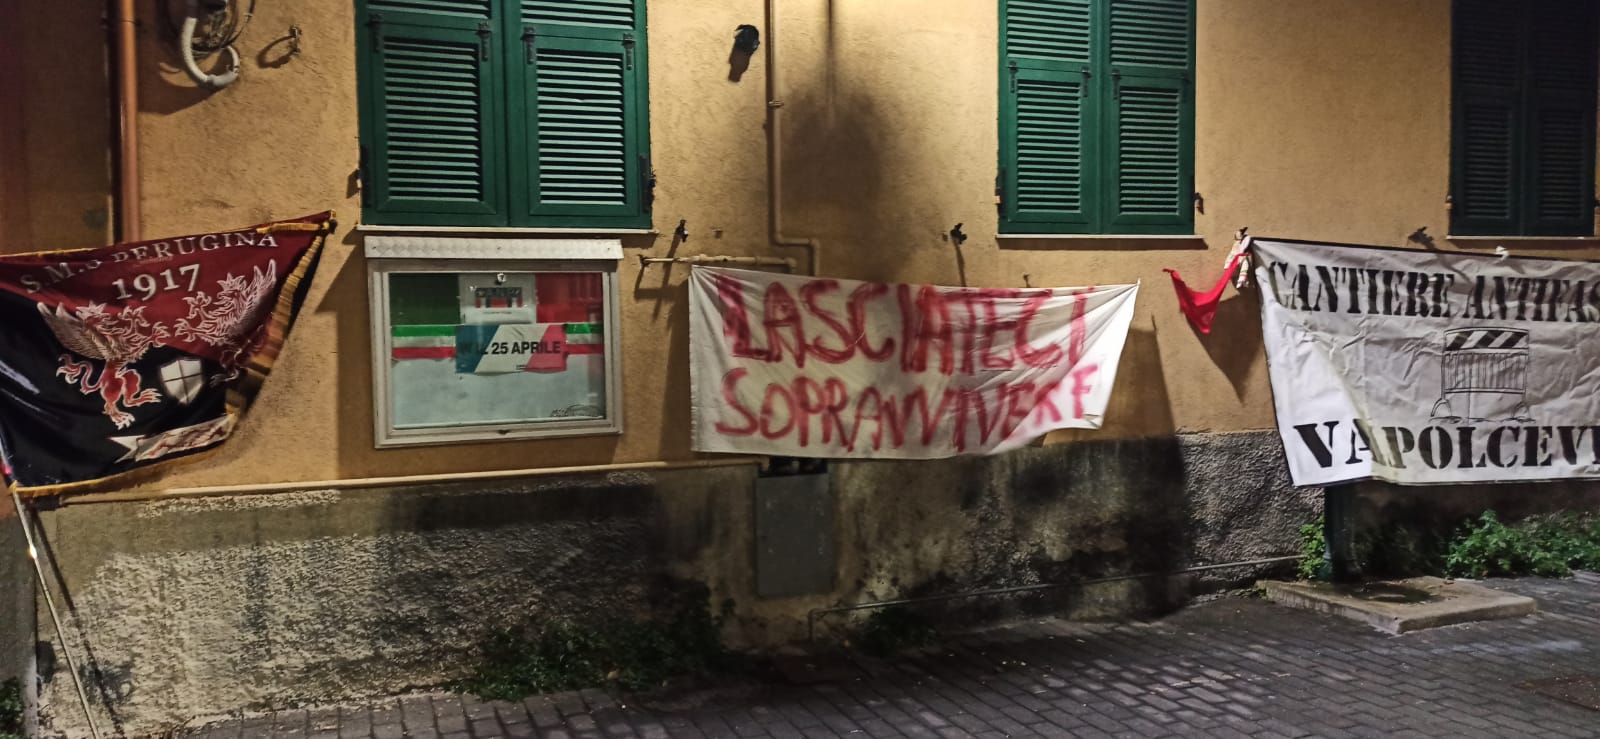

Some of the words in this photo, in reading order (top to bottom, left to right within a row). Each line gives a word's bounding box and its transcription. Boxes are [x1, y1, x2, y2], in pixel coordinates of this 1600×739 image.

[112, 263, 201, 301] 1917
[1269, 261, 1454, 318] CANTIERE
[491, 341, 508, 354] 25
[511, 341, 561, 354] APRILE
[715, 273, 1095, 376] LASCIATECI
[716, 364, 1098, 453] SOPRAVVIVERE
